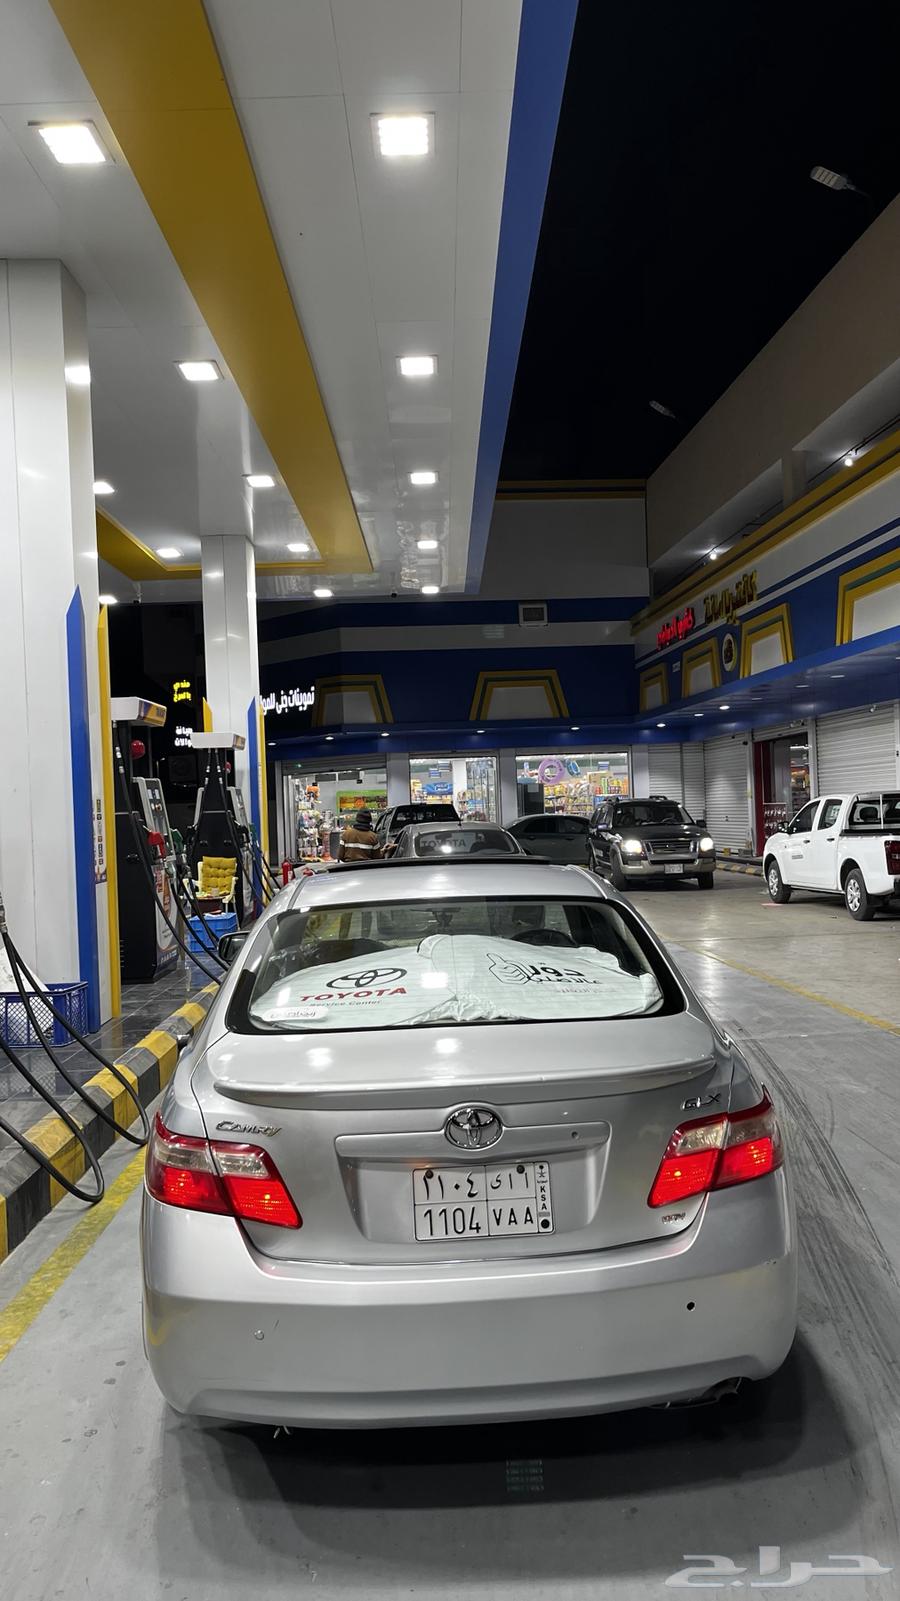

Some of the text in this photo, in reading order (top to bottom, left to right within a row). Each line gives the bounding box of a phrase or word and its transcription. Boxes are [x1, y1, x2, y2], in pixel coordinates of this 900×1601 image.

[300, 987, 407, 1002] TOYOTA
[682, 1093, 721, 1110] GLX
[540, 1185, 548, 1211] KSA
[423, 1206, 482, 1237] 1104
